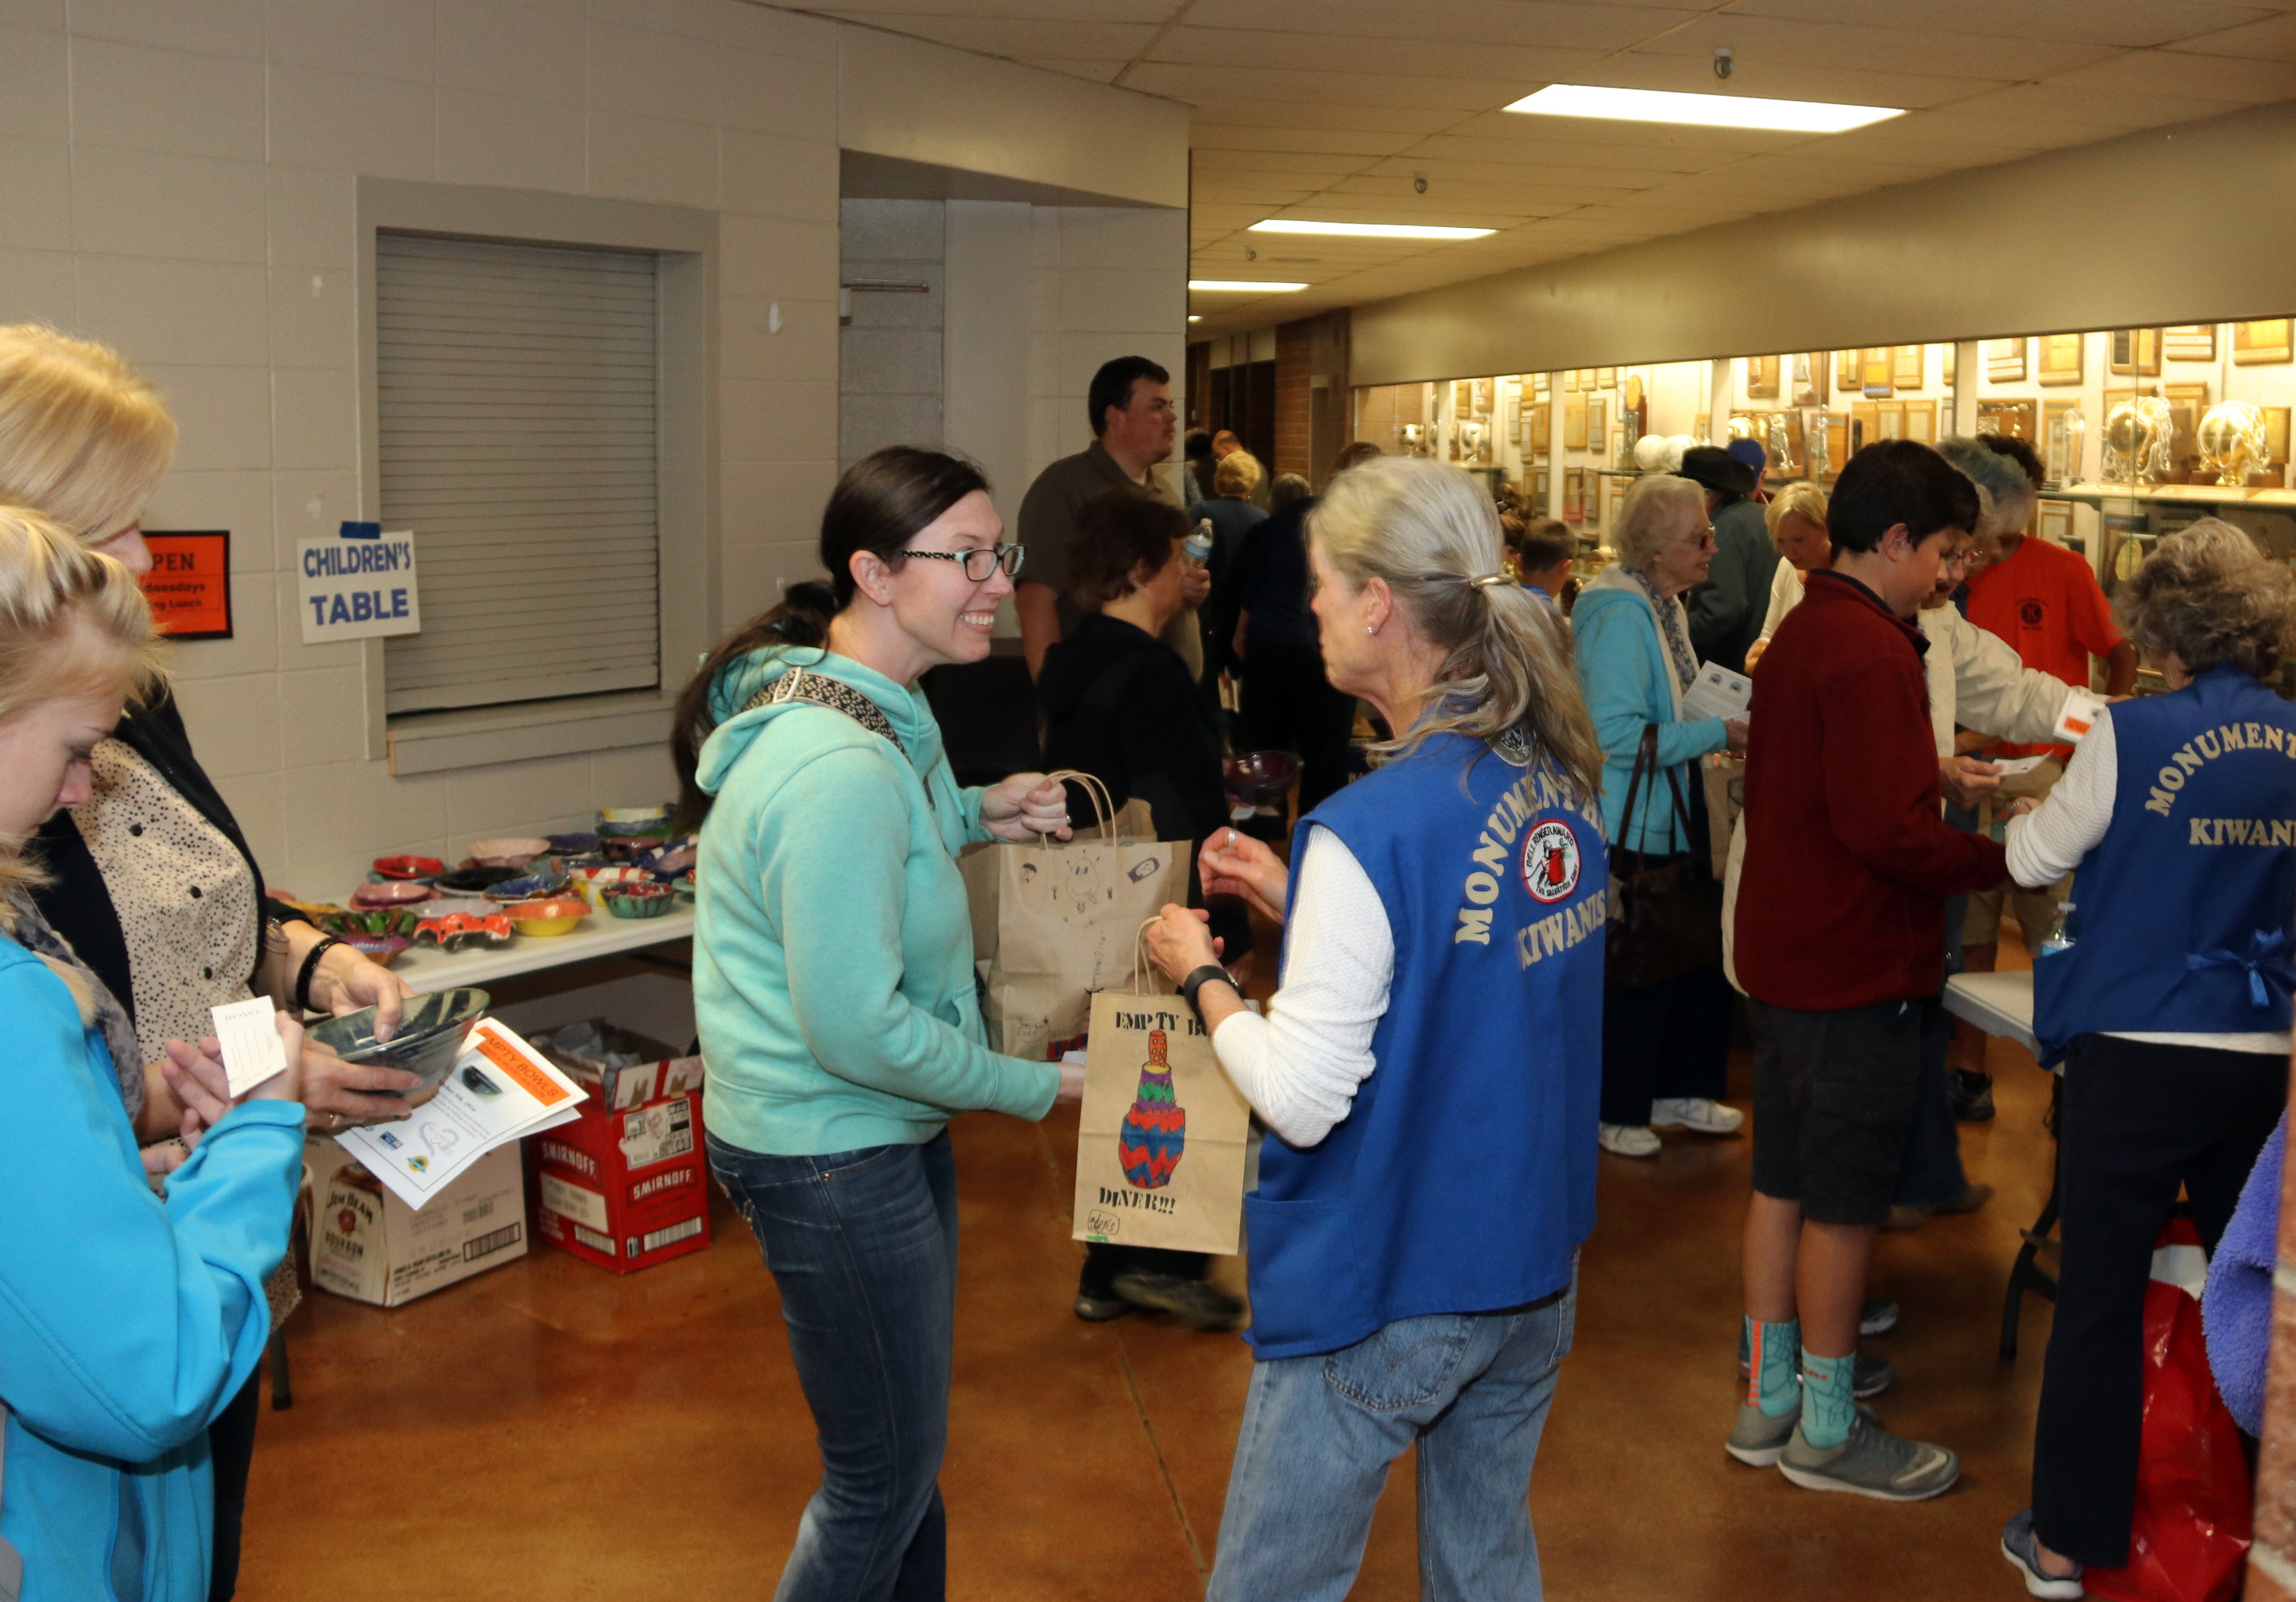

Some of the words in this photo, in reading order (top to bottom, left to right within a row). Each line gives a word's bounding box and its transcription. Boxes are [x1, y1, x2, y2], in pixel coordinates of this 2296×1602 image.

[152, 552, 194, 570] PEN
[303, 541, 411, 578] CHILDREN'S
[309, 588, 409, 626] TABLE
[1526, 844, 1537, 868] BELL
[1532, 826, 1553, 844] RINGER
[1552, 826, 1574, 846] AWARD
[1518, 889, 1606, 971] KIWANIS
[1115, 1012, 1180, 1031] EMPTY
[516, 1063, 558, 1096] BOWLS
[543, 1142, 595, 1177] SMIRNOFF
[633, 1169, 691, 1201] SMIRNOFF
[1099, 1187, 1176, 1215] DINER!!!
